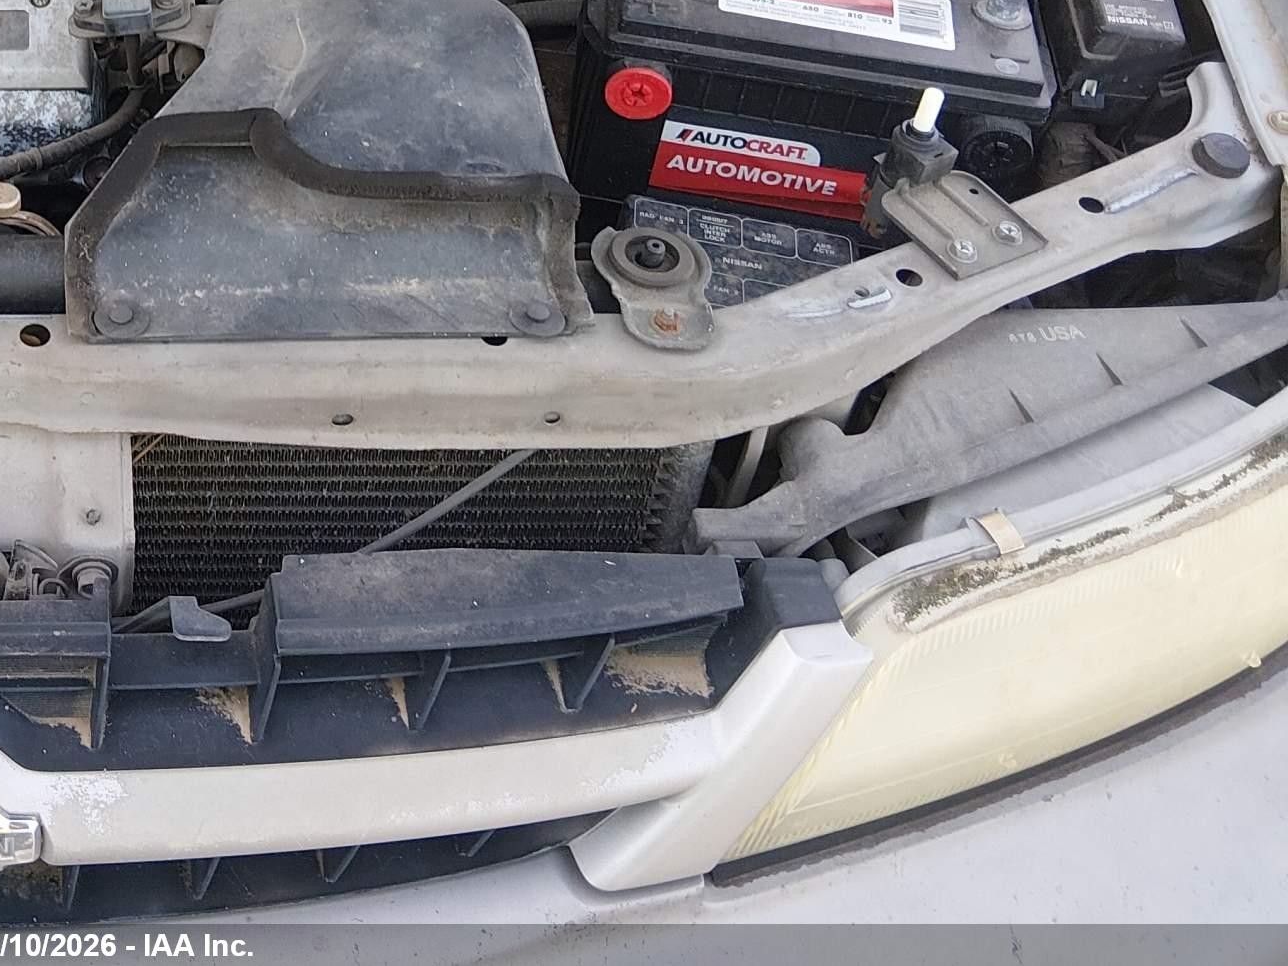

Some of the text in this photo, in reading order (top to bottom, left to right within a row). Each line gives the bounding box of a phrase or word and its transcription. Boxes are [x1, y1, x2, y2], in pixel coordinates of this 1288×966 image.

[1107, 16, 1148, 26] NISSAN
[690, 130, 808, 160] AUTOCRAFT
[667, 154, 837, 196] AUTOMOTIVE
[699, 223, 730, 233] CLUTCH
[704, 234, 725, 243] LOCK
[754, 235, 782, 246] MOTOR
[722, 257, 763, 270] NISSAN
[1038, 324, 1087, 342] USA
